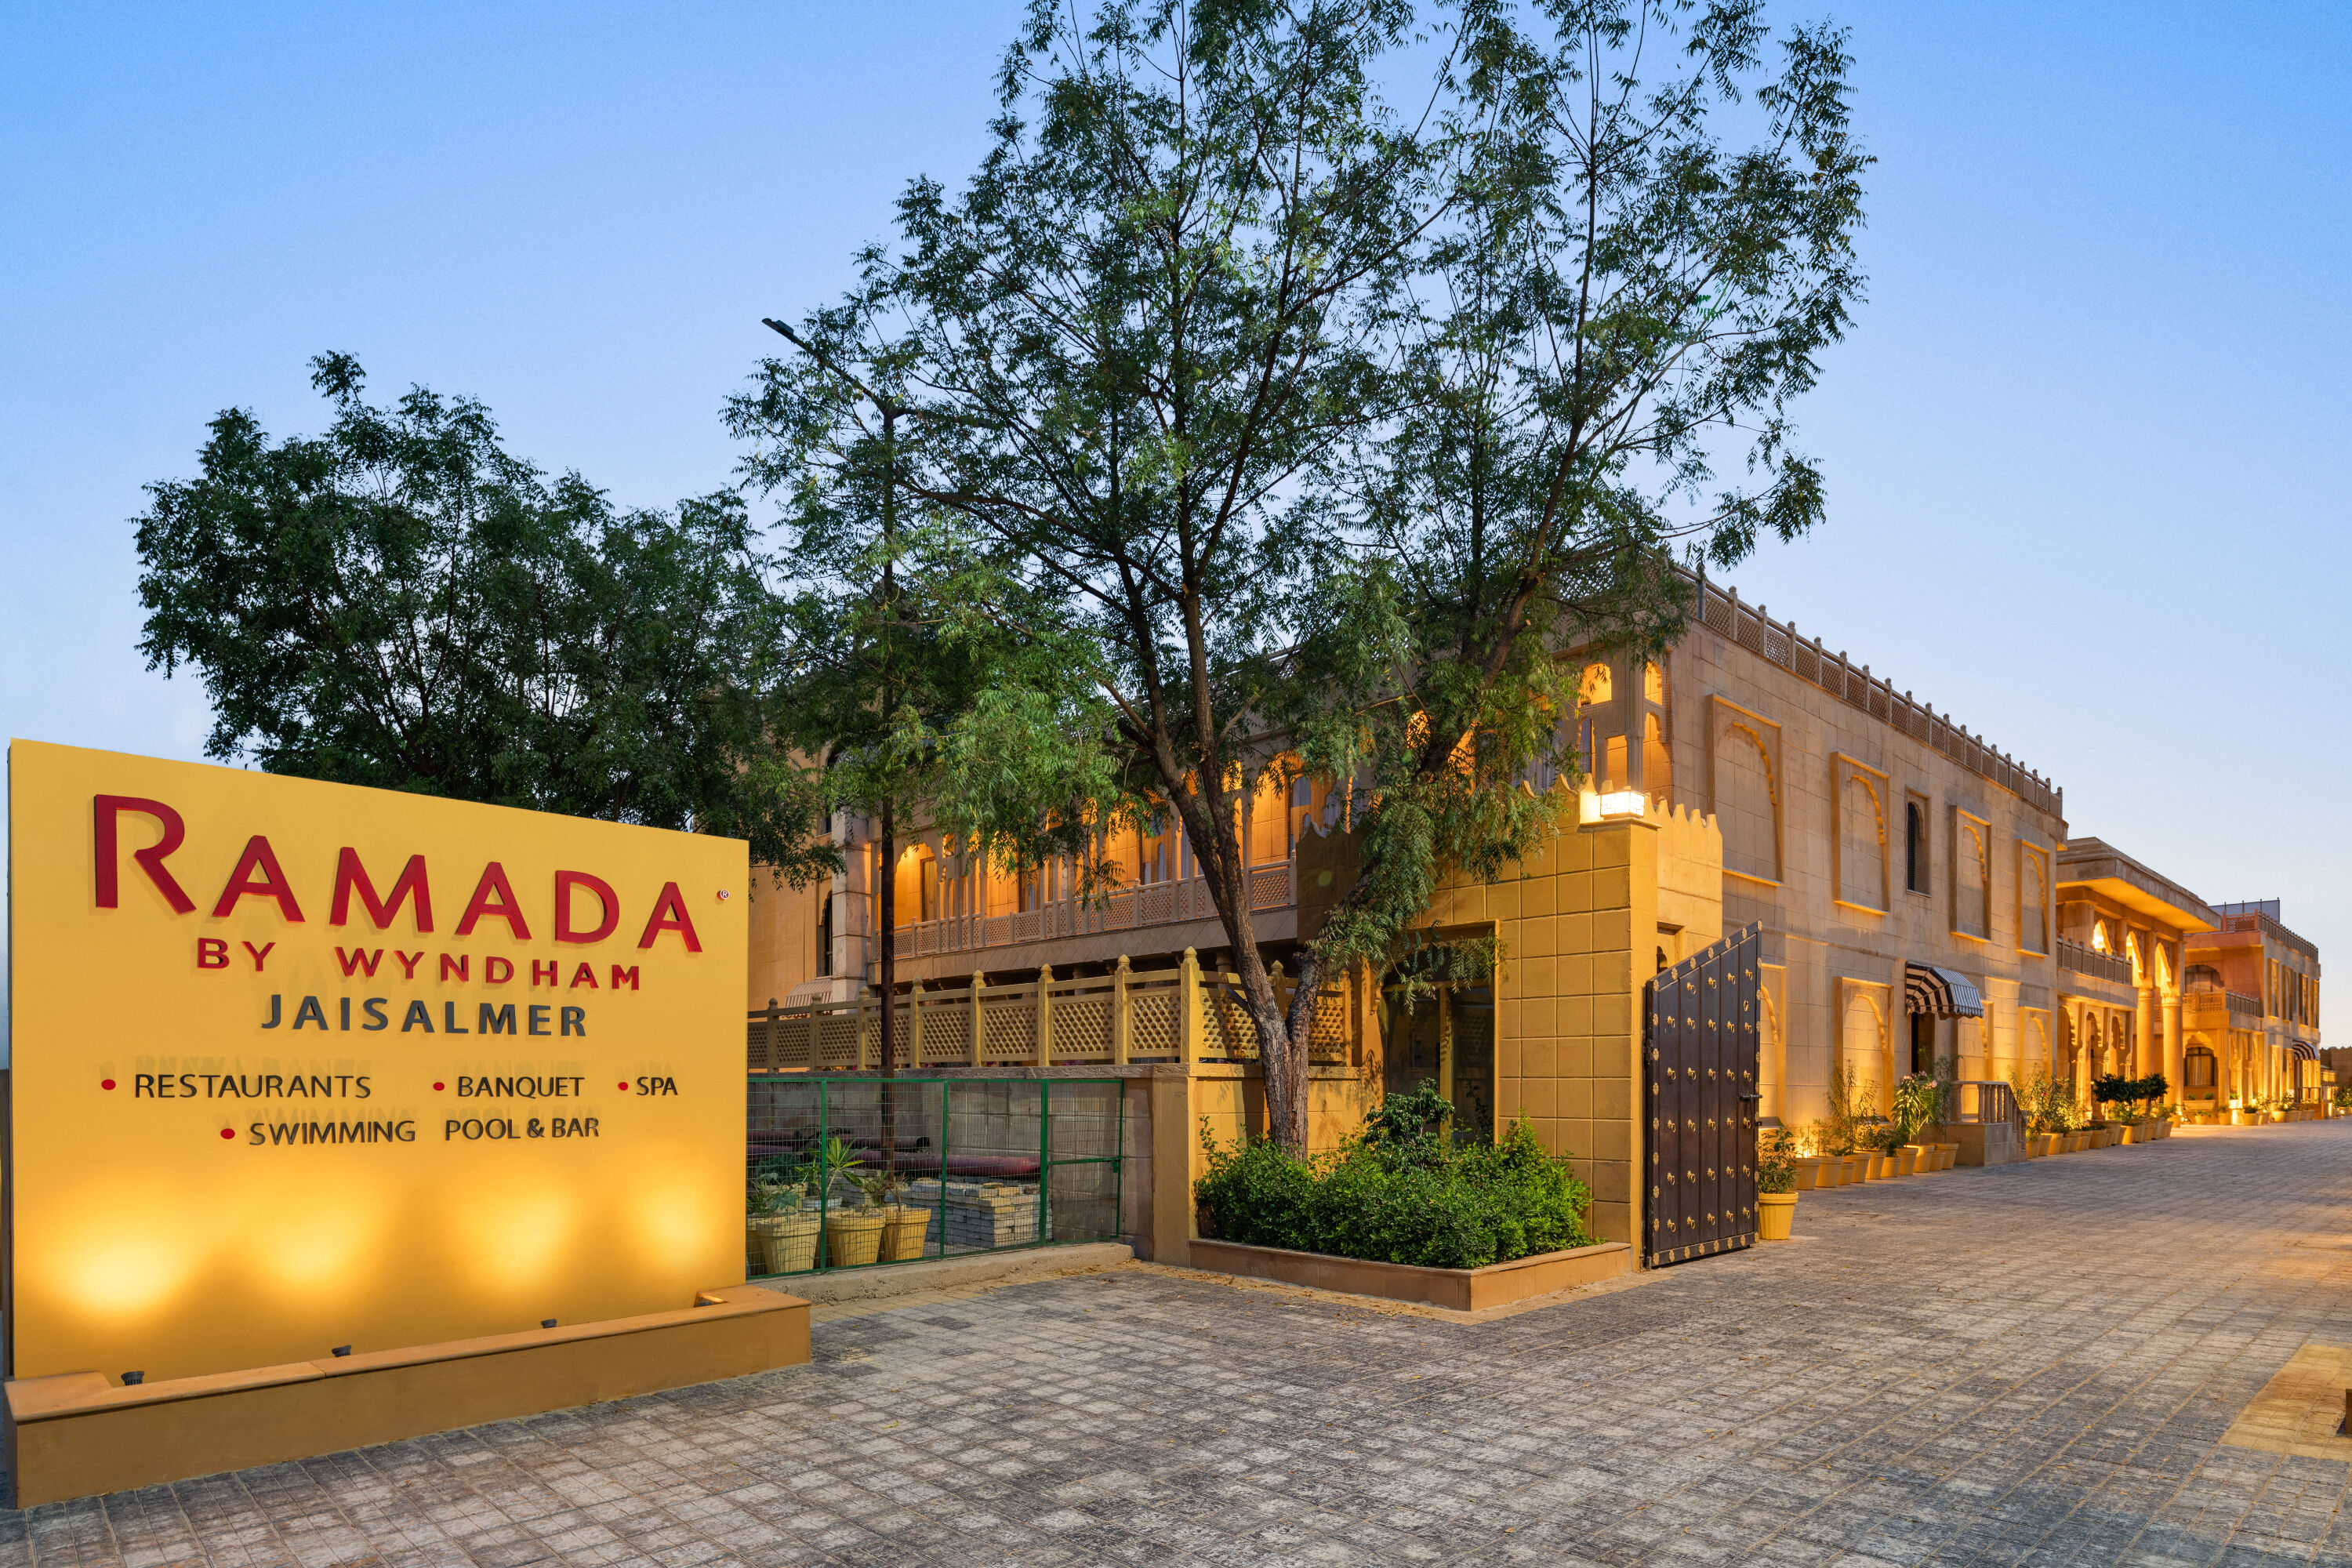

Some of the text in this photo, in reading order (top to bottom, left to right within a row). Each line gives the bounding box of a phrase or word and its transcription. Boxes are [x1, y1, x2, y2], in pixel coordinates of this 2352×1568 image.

[95, 794, 702, 953] RAMADA
[197, 938, 640, 990] BY WYNDHAM
[261, 993, 586, 1036] JAISALMER
[134, 1073, 678, 1099] RESTAURANTS BANQUET SPA
[249, 1117, 600, 1145] SWIMMING POOL & BAR
